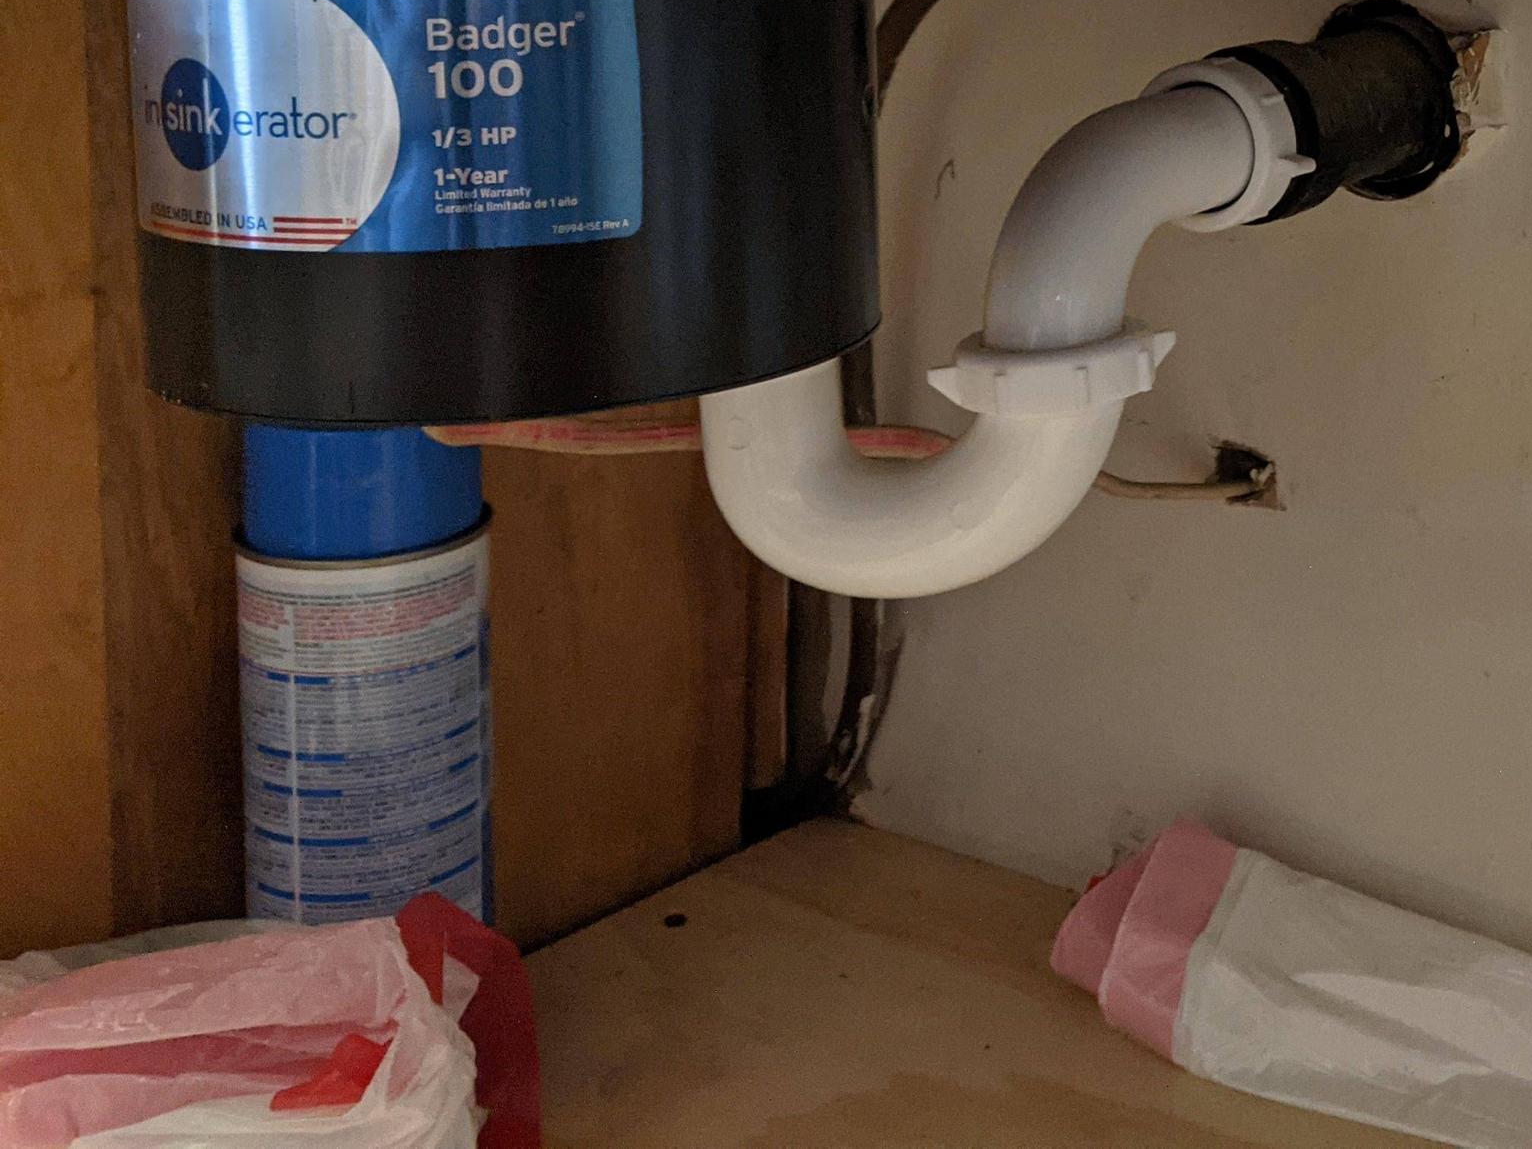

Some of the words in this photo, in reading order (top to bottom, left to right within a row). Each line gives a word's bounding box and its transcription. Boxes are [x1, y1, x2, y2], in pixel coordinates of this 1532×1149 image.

[426, 16, 576, 56] Badger
[427, 58, 524, 99] 100
[432, 127, 472, 149] 1/3
[480, 126, 518, 146] HP
[433, 167, 509, 186] 1-Year
[434, 187, 478, 200] Limited
[480, 186, 532, 199] Warranty
[486, 200, 531, 212] limitada
[534, 198, 547, 209] de
[217, 213, 231, 228] IN
[235, 216, 267, 231] USA
[622, 218, 630, 228] A
